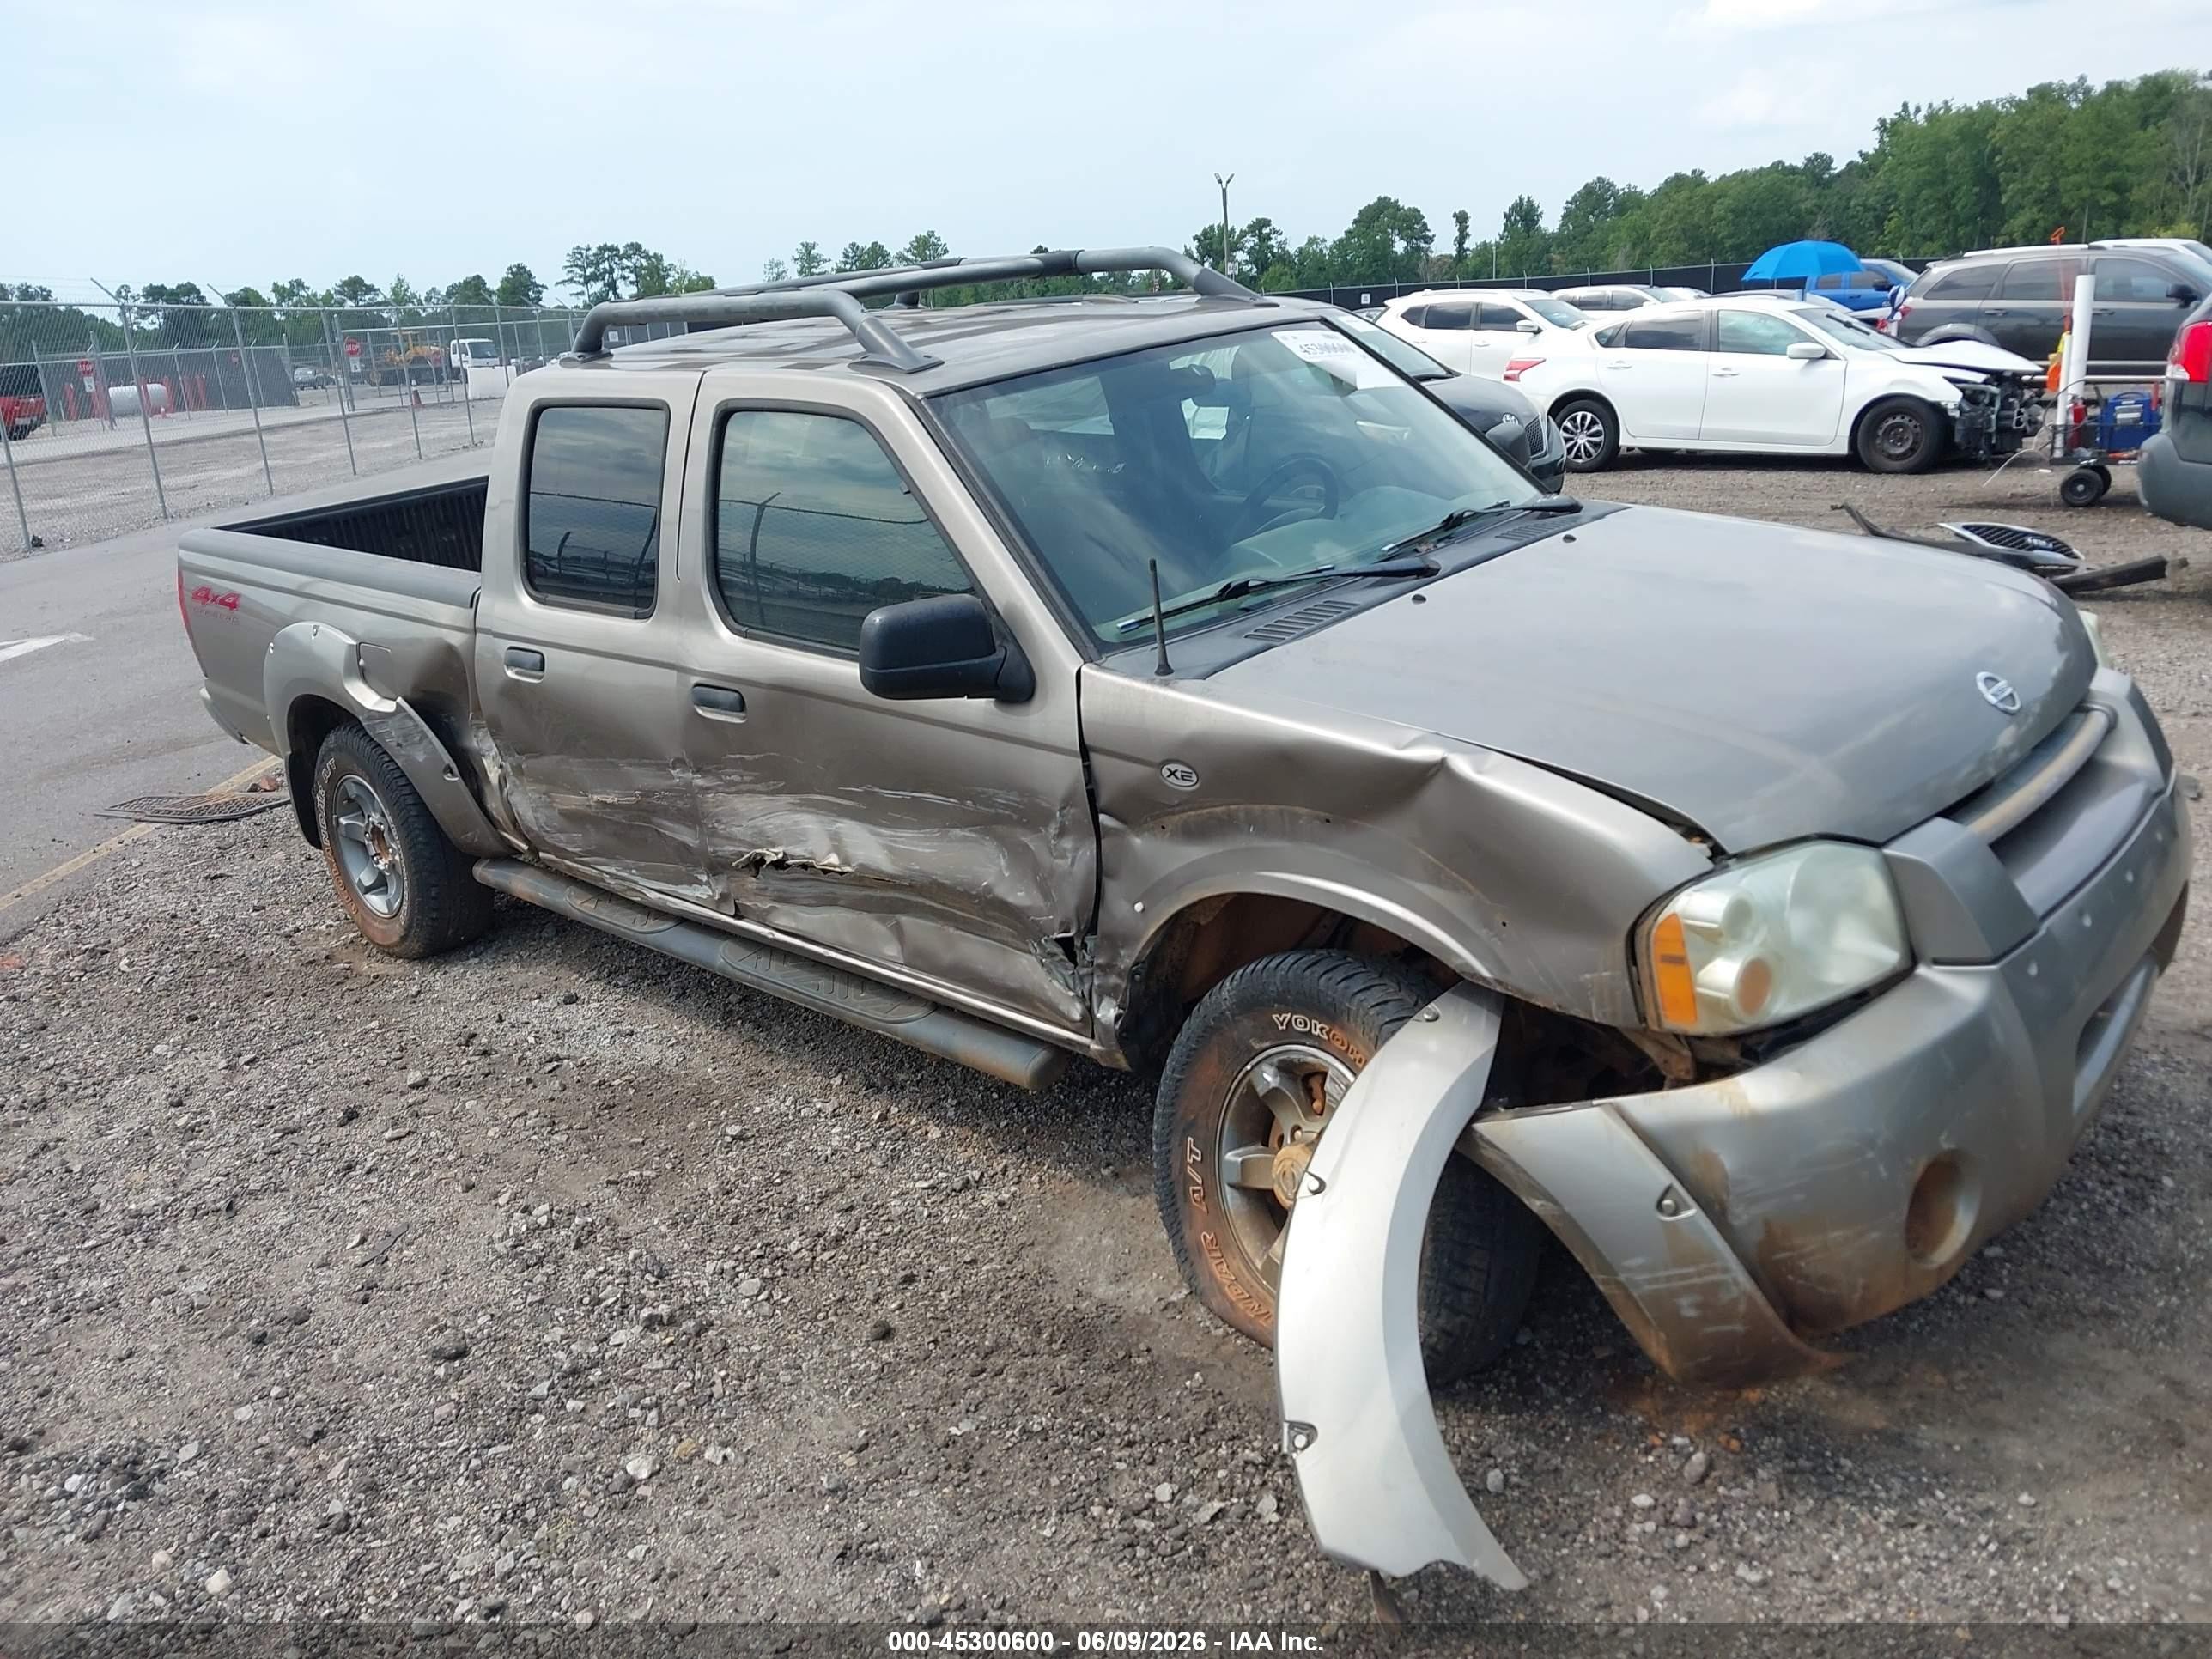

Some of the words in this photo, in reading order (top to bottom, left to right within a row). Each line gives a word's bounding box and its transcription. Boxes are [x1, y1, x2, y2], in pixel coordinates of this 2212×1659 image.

[321, 757, 337, 784] A/T
[1165, 766, 1194, 783] XE
[1272, 1012, 1367, 1068] YOKOH
[1187, 1136, 1209, 1215] A/T
